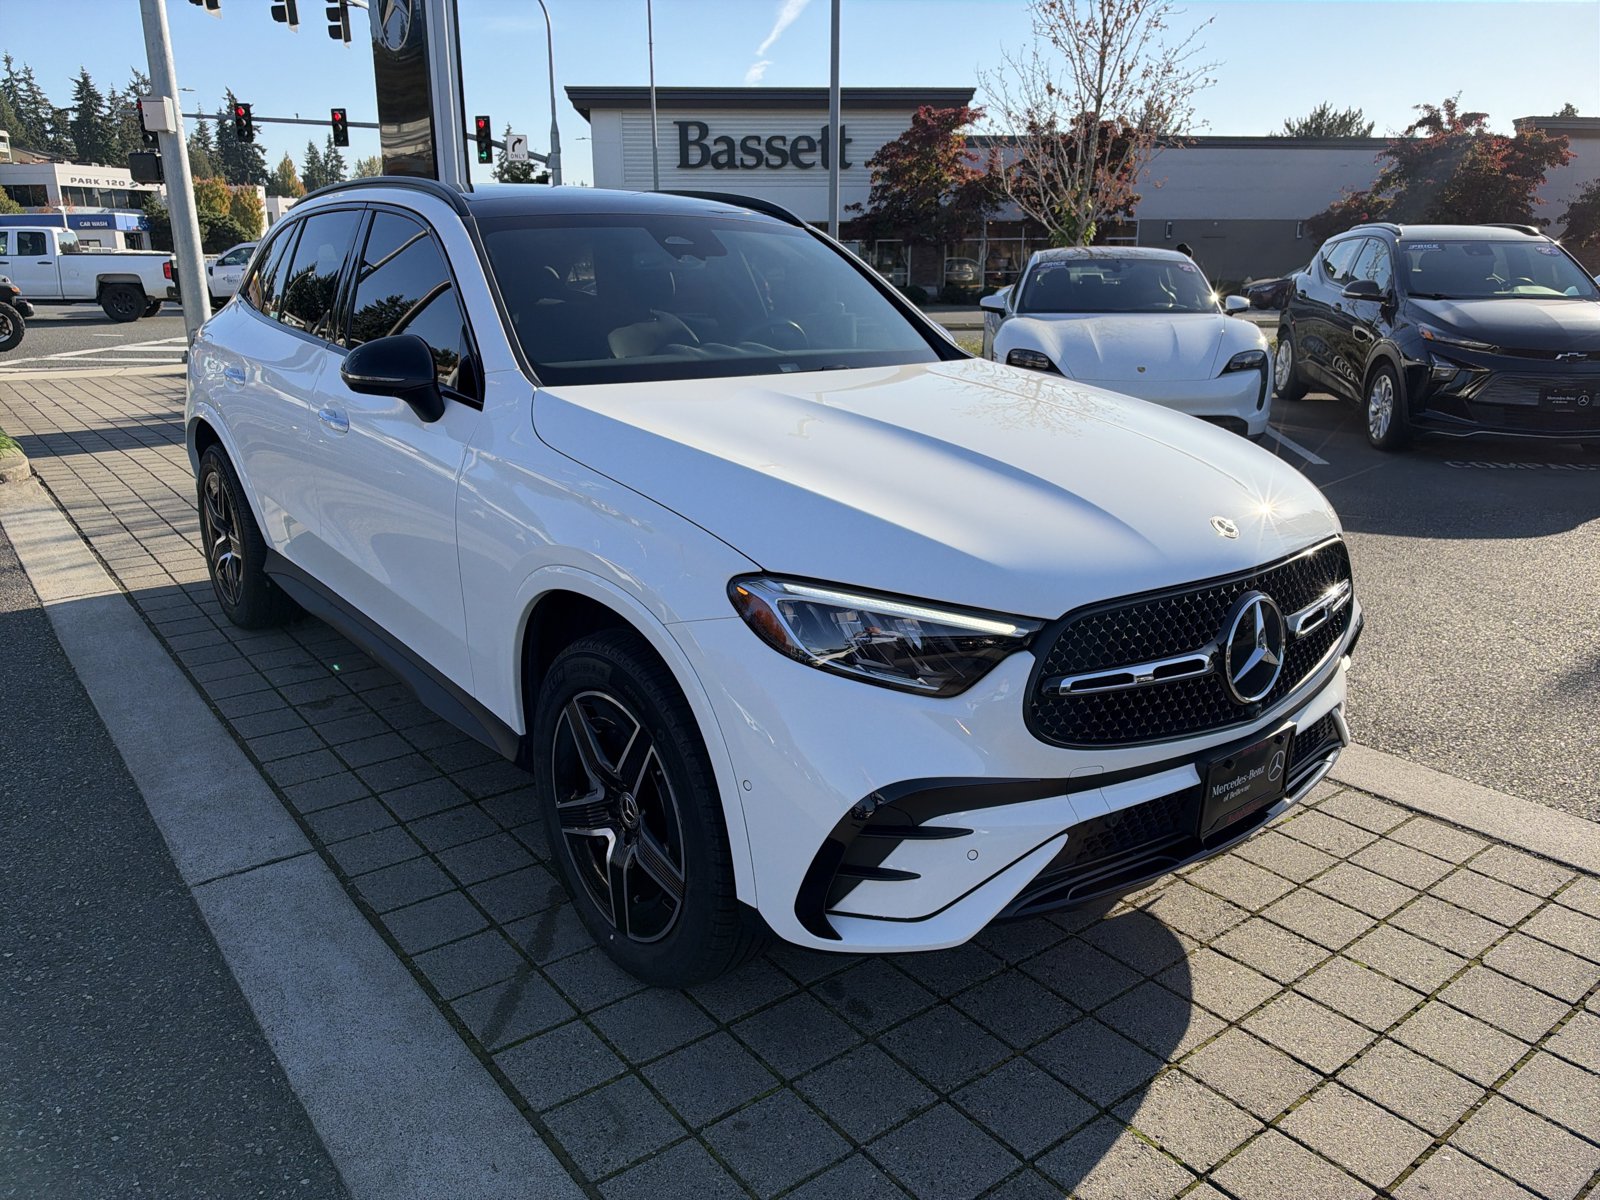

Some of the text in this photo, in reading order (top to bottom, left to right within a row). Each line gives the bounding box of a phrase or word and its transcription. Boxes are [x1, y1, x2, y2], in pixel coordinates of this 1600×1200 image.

[673, 121, 853, 170] Bassett
[70, 177, 100, 185] PARK
[1211, 765, 1265, 797] Mercedes-Benz
